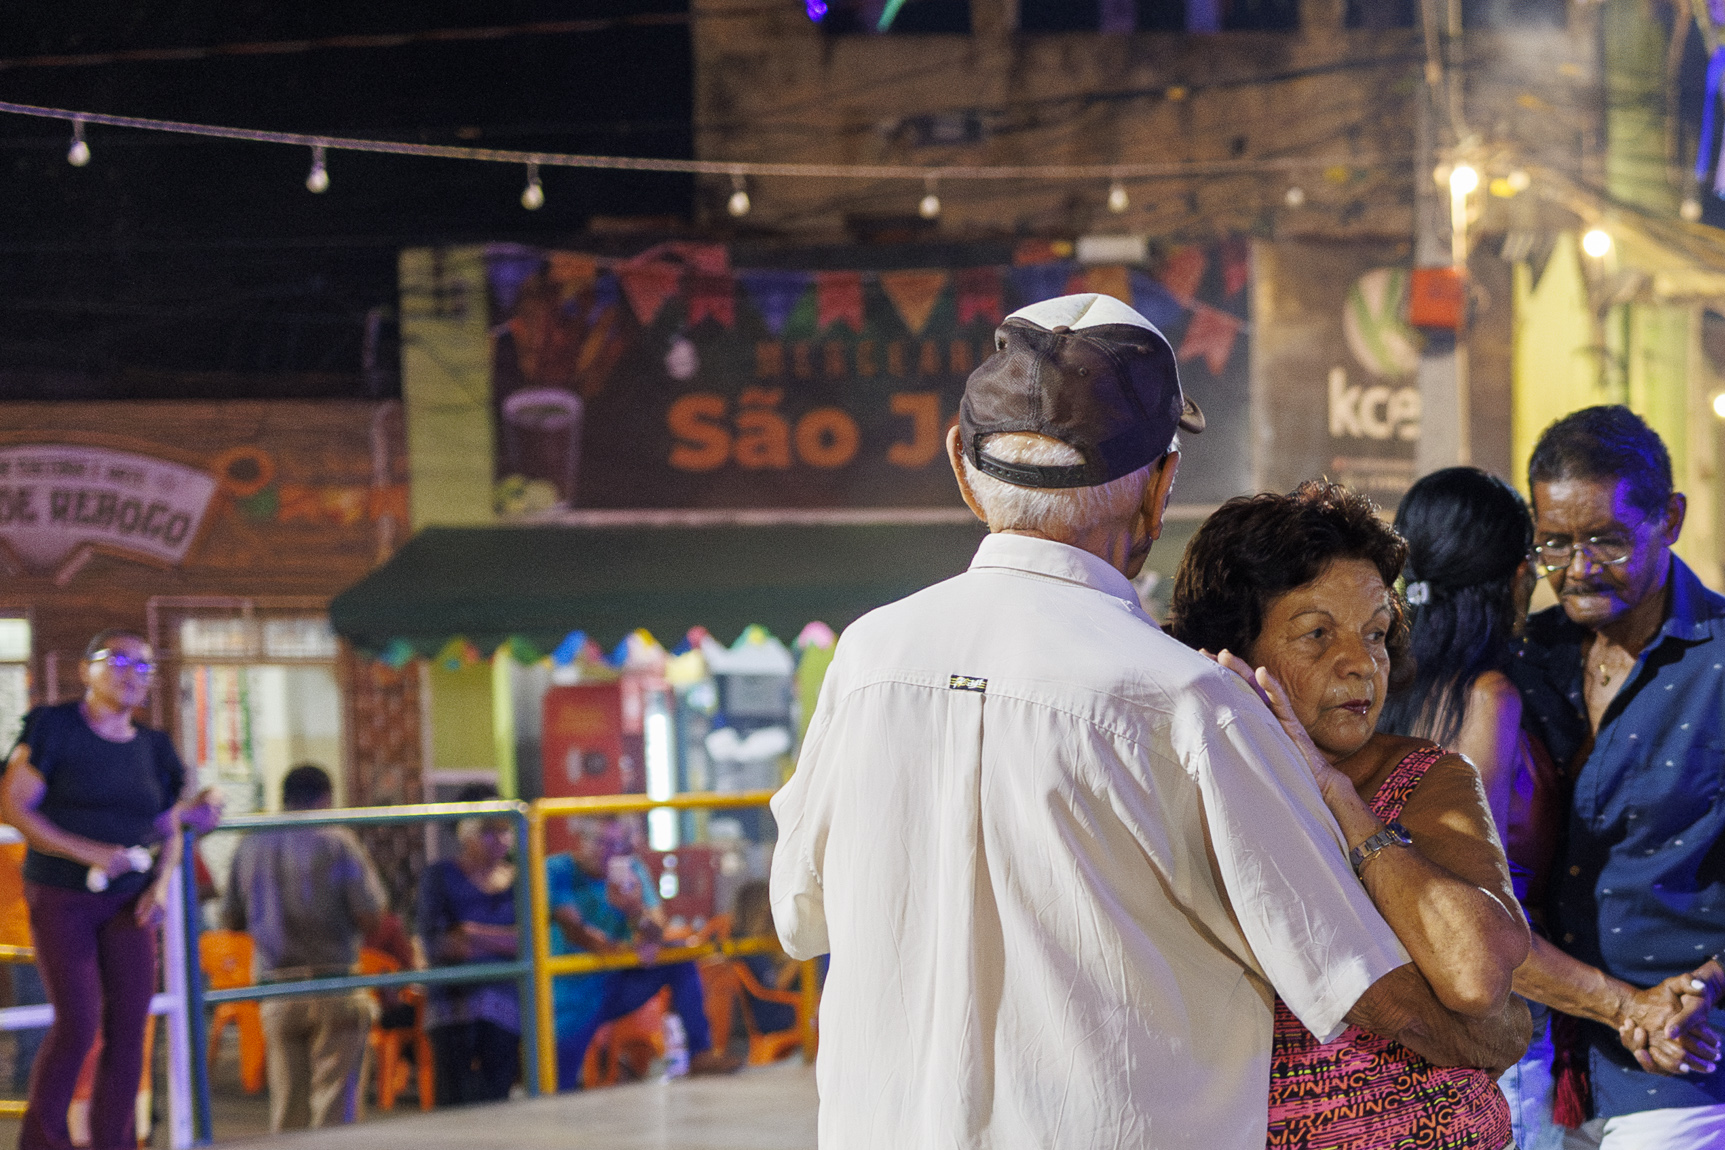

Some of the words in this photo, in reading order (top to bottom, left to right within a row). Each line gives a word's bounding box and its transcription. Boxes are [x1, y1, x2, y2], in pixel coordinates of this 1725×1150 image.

[668, 388, 860, 469] São
[887, 391, 960, 468] J
[1286, 1095, 1401, 1130] TRAINING
